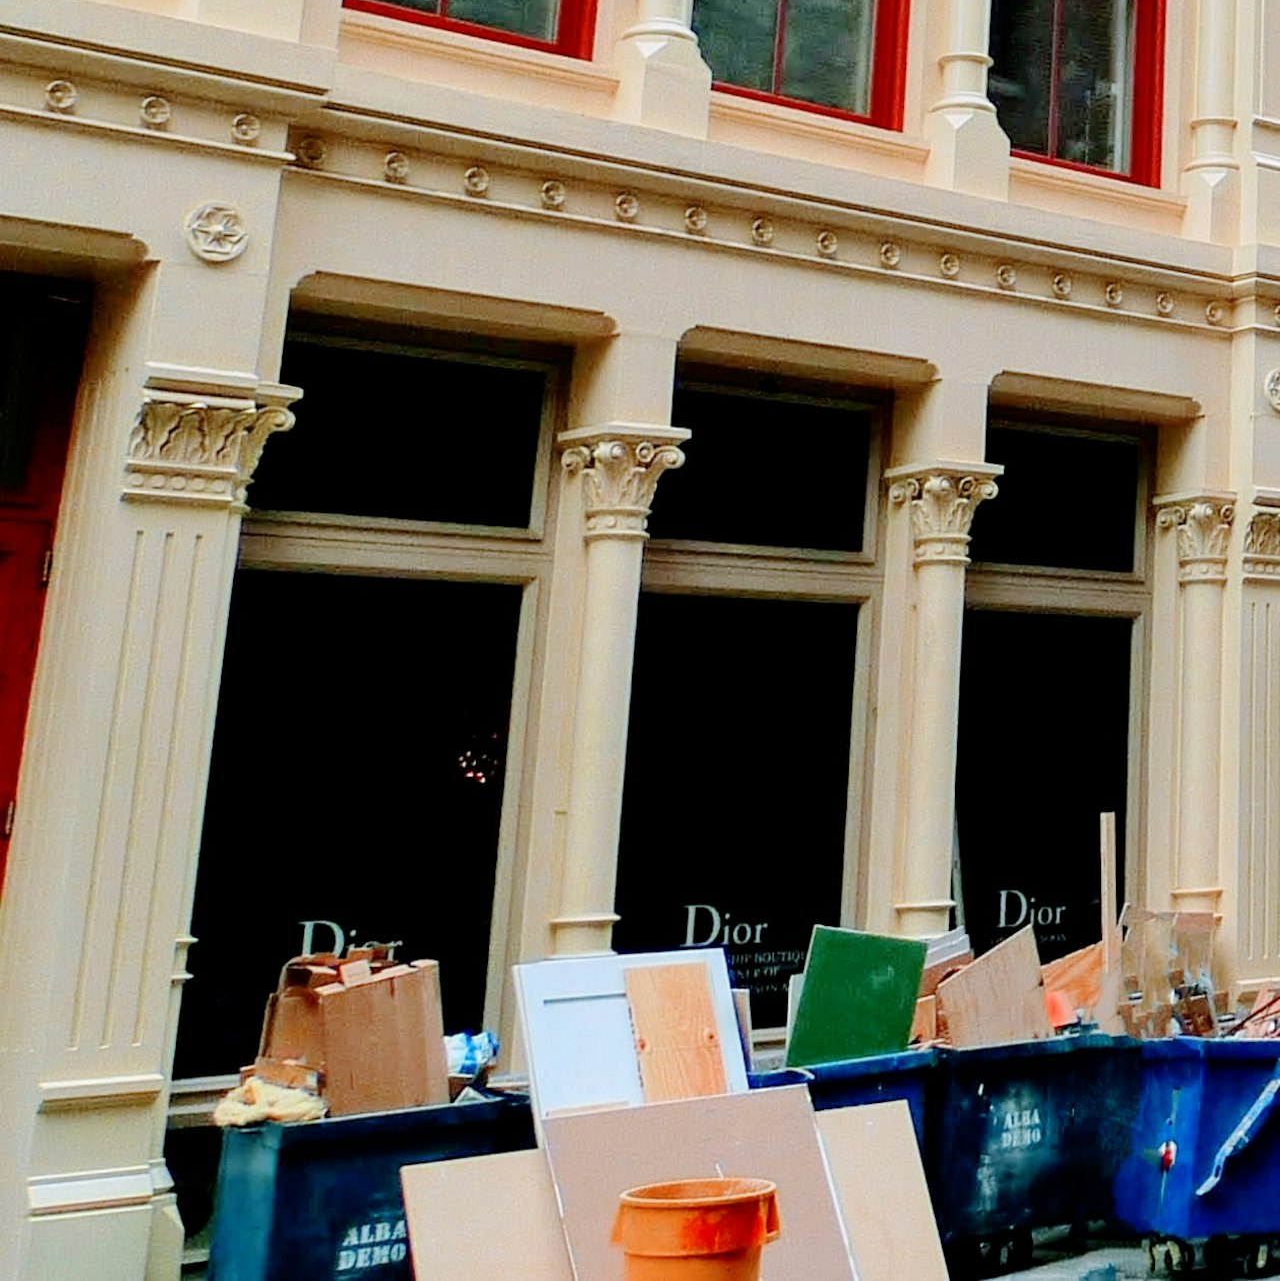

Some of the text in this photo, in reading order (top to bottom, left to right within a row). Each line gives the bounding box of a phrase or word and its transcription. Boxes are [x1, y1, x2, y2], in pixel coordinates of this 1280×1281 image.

[680, 904, 769, 947] Dior
[997, 889, 1067, 929] Dior
[342, 1220, 407, 1247] ALBA
[336, 1243, 407, 1271] DEMO
